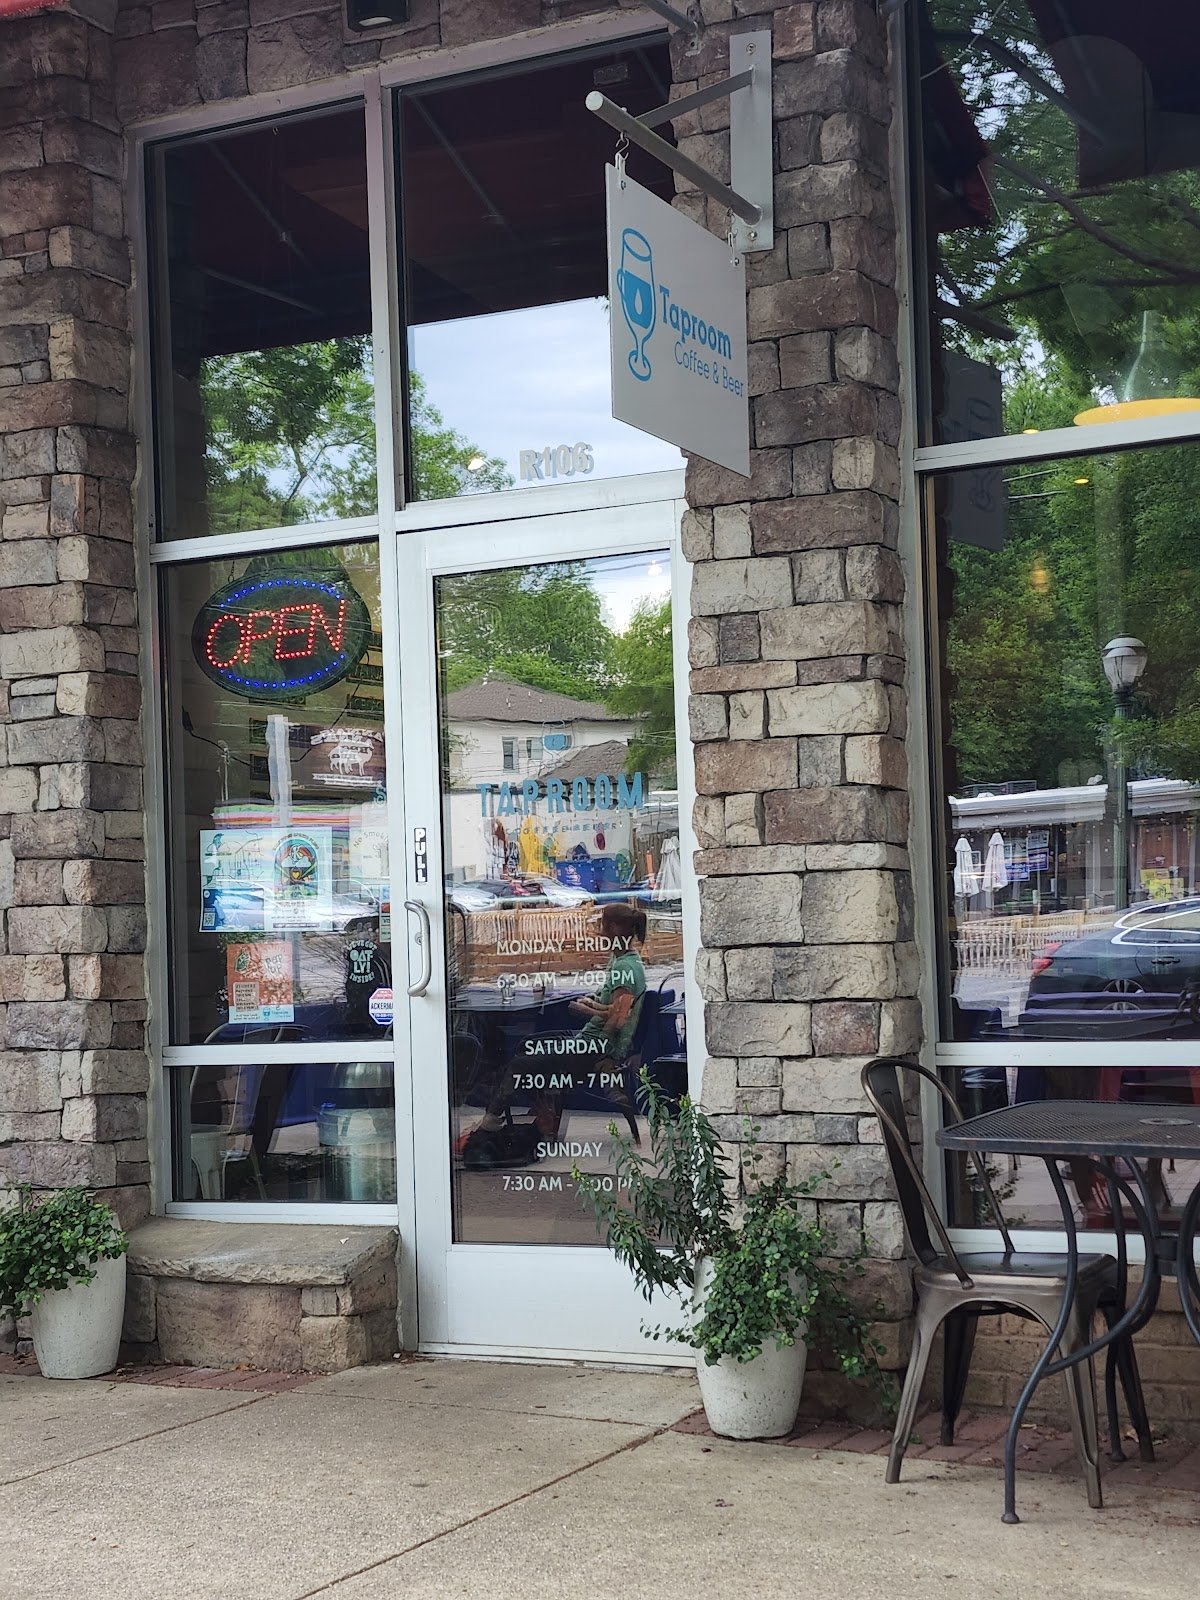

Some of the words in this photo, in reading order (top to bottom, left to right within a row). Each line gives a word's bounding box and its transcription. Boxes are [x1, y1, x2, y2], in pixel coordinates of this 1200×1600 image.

[659, 285, 732, 360] Taproom
[674, 341, 710, 380] Coffee
[712, 361, 720, 384] &
[722, 366, 745, 397] Beer
[519, 441, 592, 480] R106
[206, 598, 347, 668] OPEN
[475, 771, 645, 818] TAPROOM
[414, 828, 427, 883] PULL
[353, 961, 371, 974] LY!
[496, 972, 529, 989] 6:30
[532, 971, 557, 988] AM
[570, 969, 607, 986] 7:00
[610, 968, 635, 985] PM
[524, 1038, 609, 1056] SATURDAY
[512, 1073, 546, 1090] 7:30
[548, 1073, 574, 1089] AM
[587, 1073, 597, 1089] 7
[599, 1072, 625, 1089] PM
[536, 1141, 603, 1158] SUNDAY
[502, 1175, 535, 1192] 7:30
[538, 1175, 563, 1192] AM
